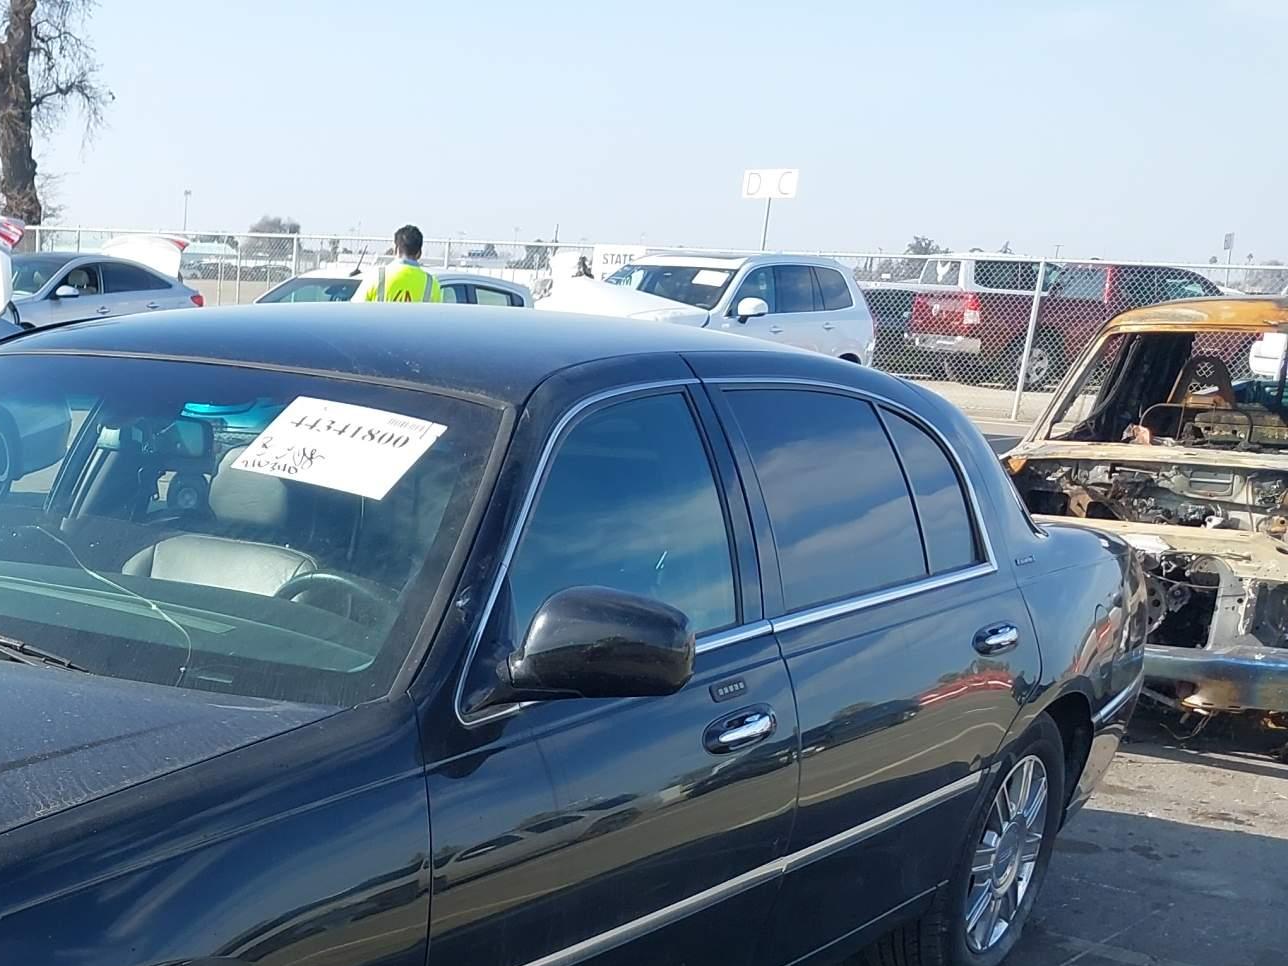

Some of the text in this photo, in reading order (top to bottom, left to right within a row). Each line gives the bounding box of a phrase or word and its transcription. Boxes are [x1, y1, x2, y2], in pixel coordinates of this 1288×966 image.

[746, 171, 793, 196] D C
[290, 414, 410, 449] 44341800
